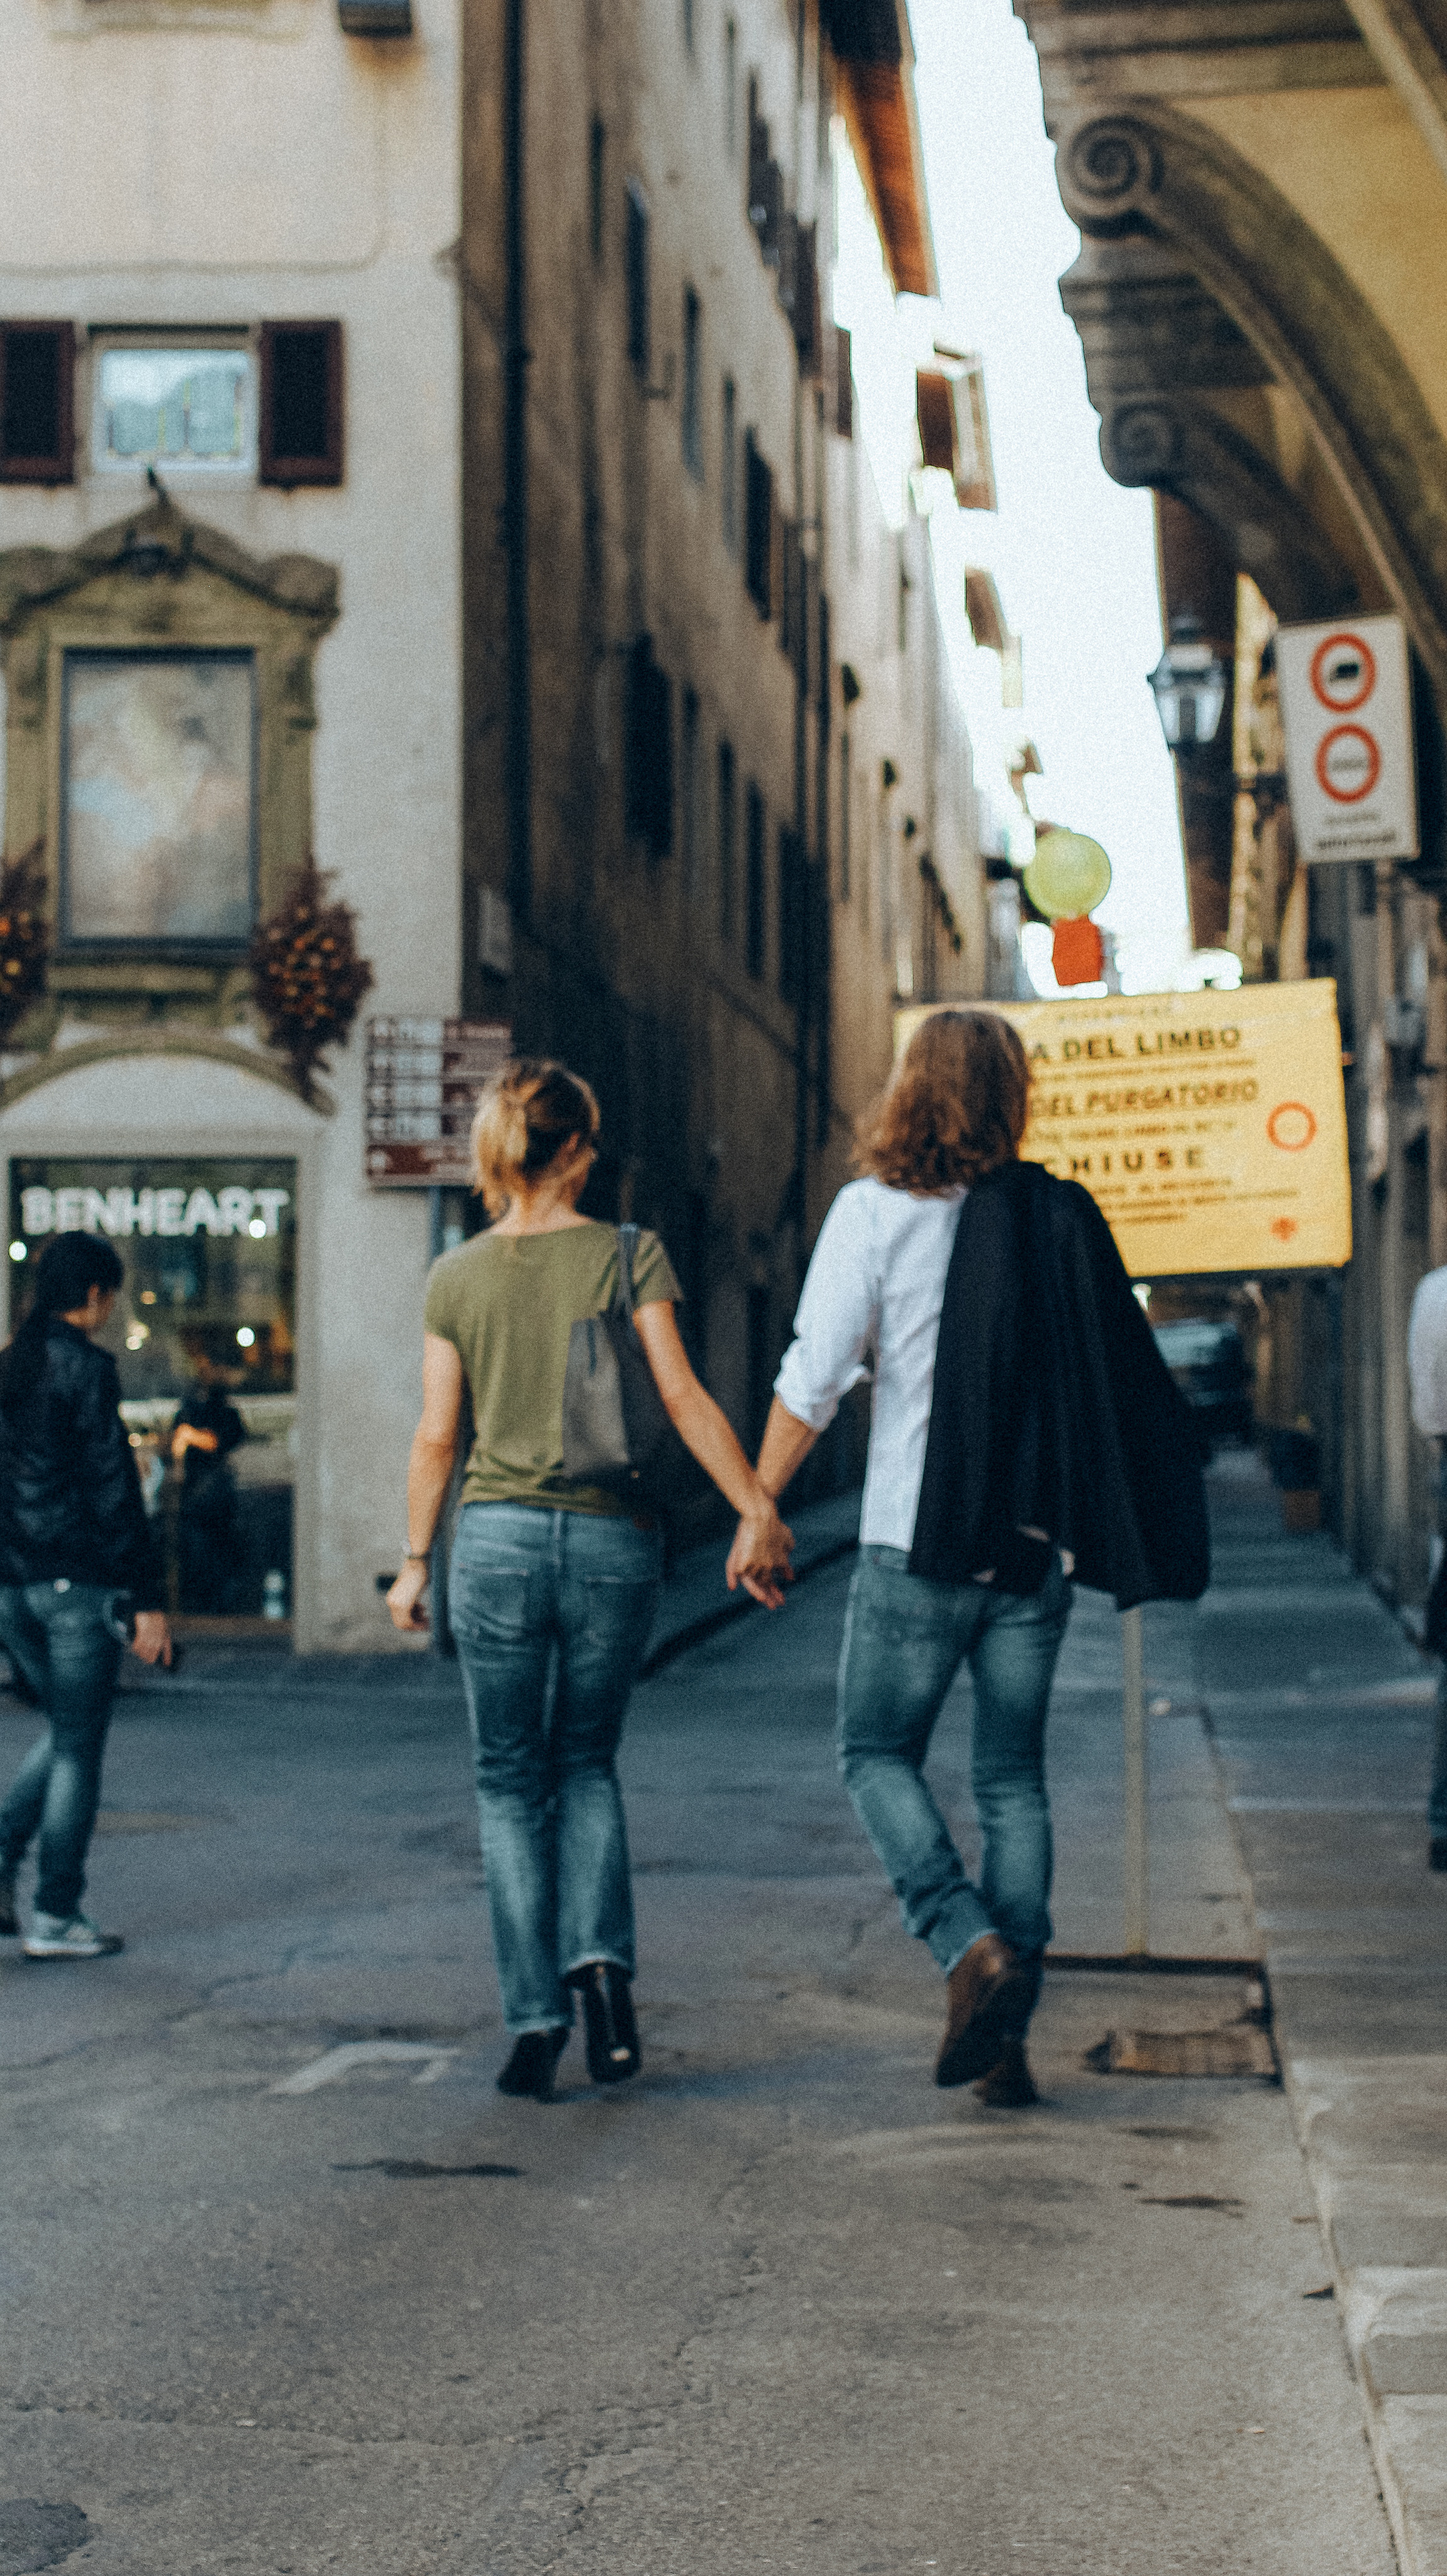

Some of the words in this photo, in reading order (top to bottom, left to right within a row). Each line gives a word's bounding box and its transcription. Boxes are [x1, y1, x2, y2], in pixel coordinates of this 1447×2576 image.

[1063, 1035, 1126, 1062] DEL
[1135, 1026, 1241, 1057] LIMBO
[1086, 1077, 1259, 1114] PURGATORIO
[21, 1186, 290, 1237] BENHEART
